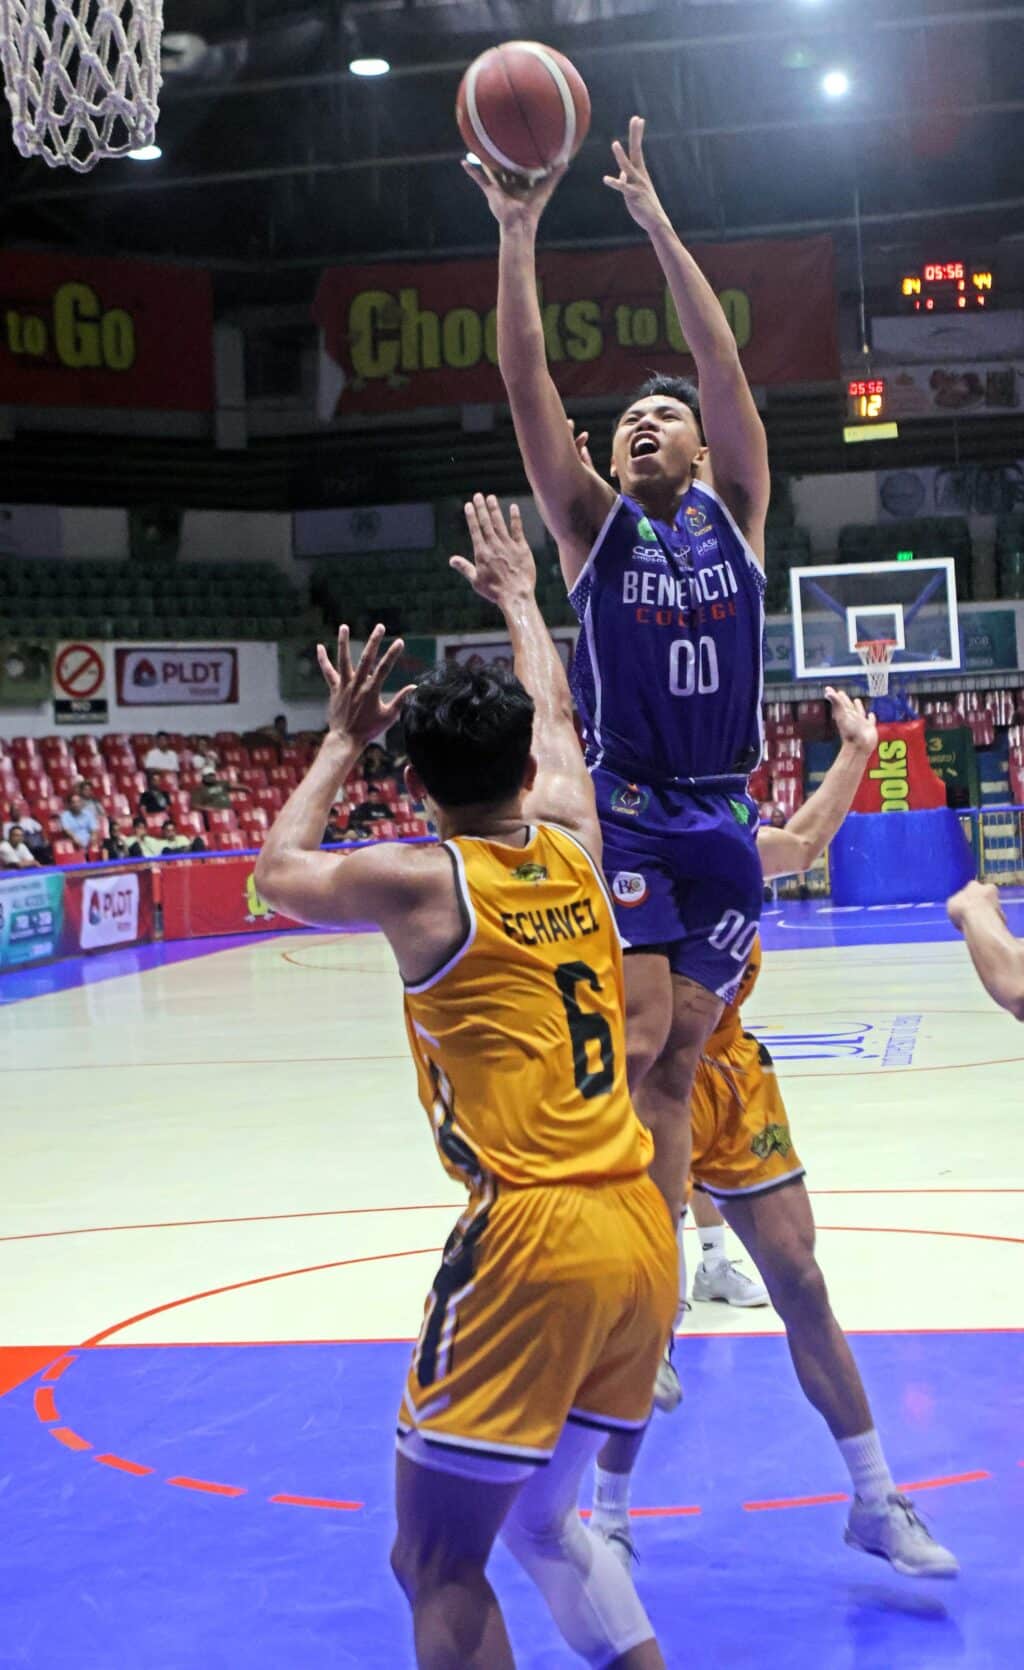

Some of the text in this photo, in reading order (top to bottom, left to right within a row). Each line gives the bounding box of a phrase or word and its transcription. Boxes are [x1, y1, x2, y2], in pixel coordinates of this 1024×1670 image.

[924, 263, 964, 281] 05:56
[6, 282, 136, 370] to Go
[616, 304, 660, 347] to
[860, 394, 882, 417] 12
[161, 660, 224, 684] PLDT
[669, 635, 720, 697] 00
[103, 889, 132, 919] PLDT
[707, 908, 761, 963] 00
[554, 960, 615, 1100] 6
